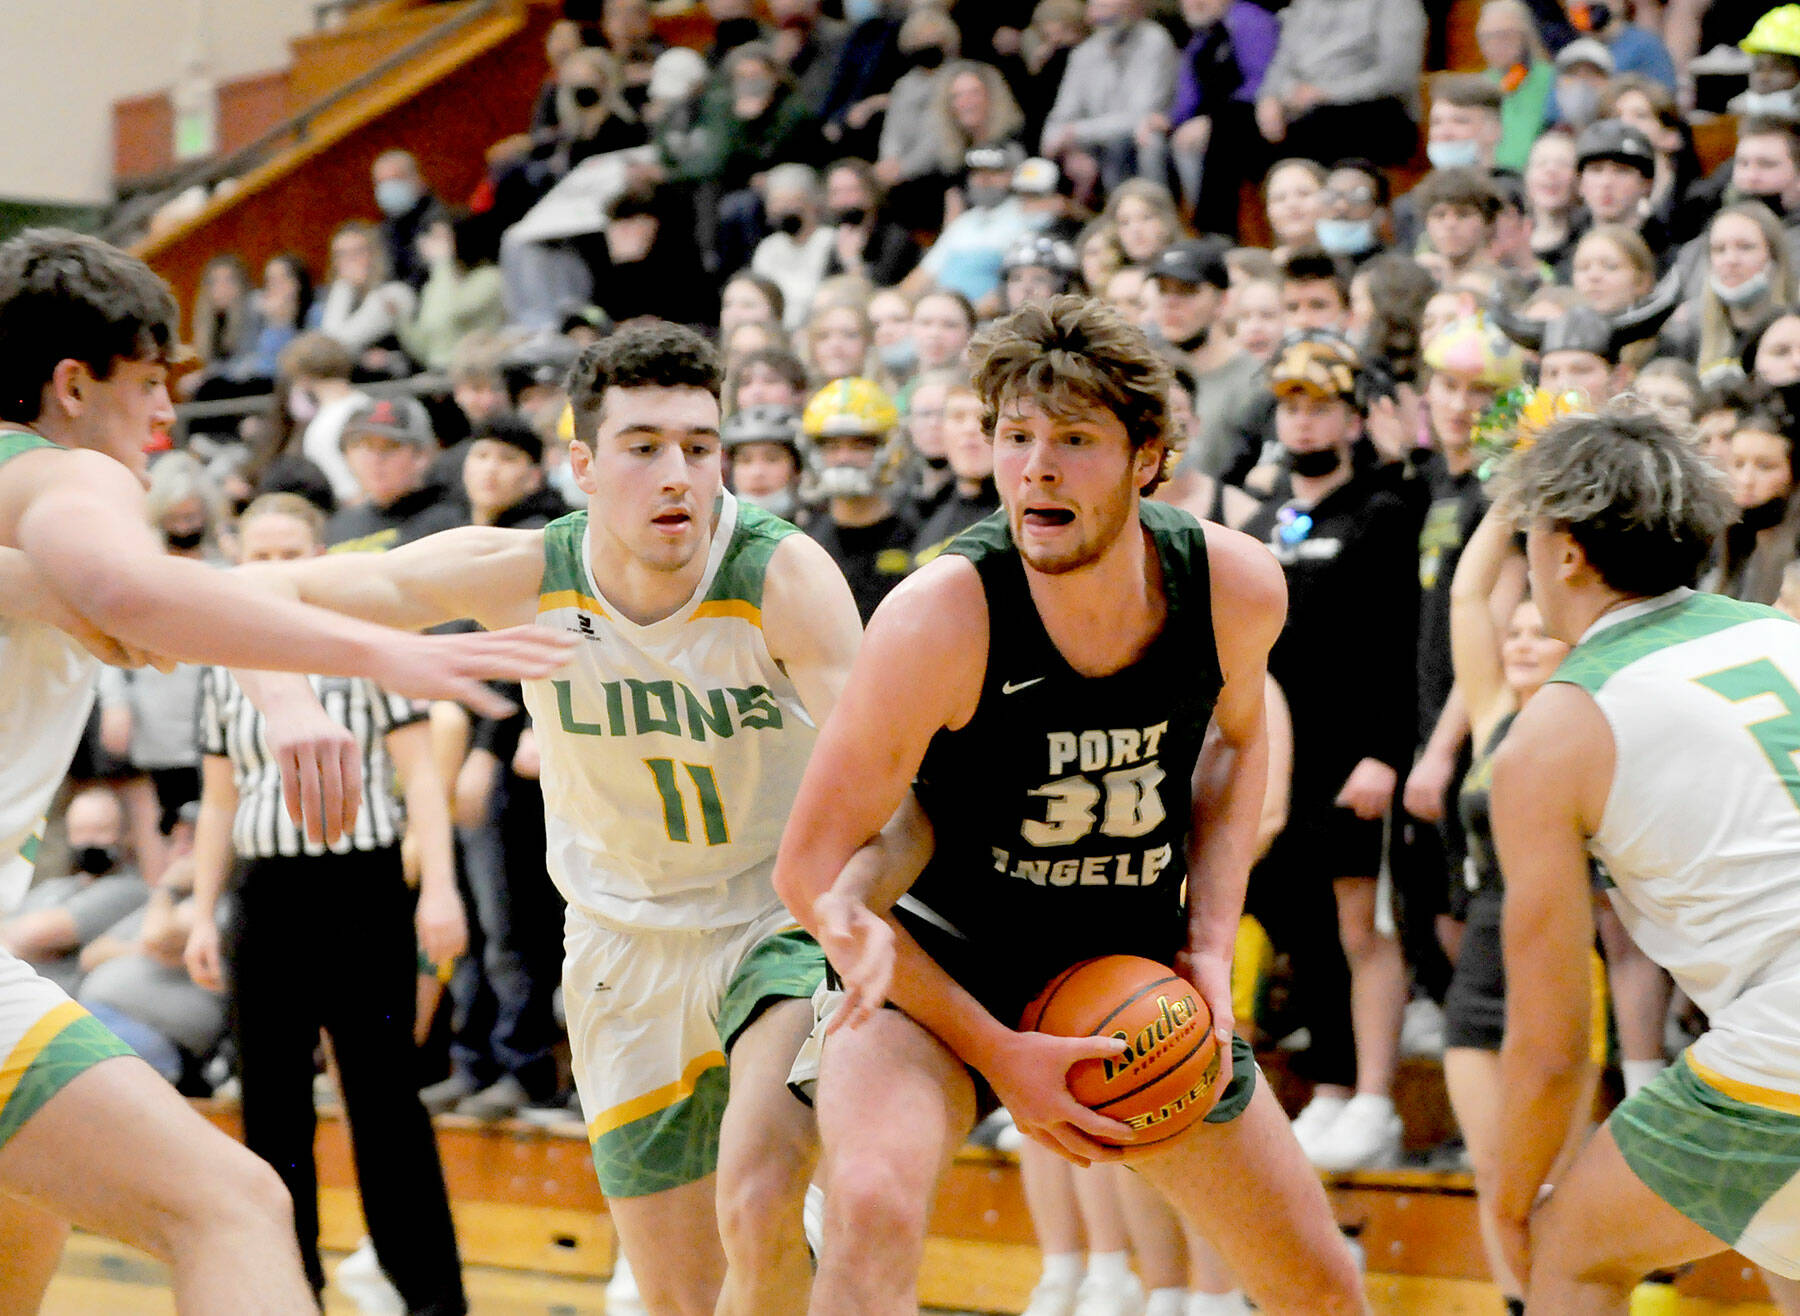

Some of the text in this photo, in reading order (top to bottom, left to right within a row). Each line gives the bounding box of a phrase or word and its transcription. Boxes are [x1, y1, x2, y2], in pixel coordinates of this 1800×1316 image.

[551, 678, 784, 742] LIONS
[1047, 720, 1168, 776] PORT
[641, 757, 731, 847] 11
[1020, 760, 1167, 848] 30
[992, 842, 1172, 887] NGELE
